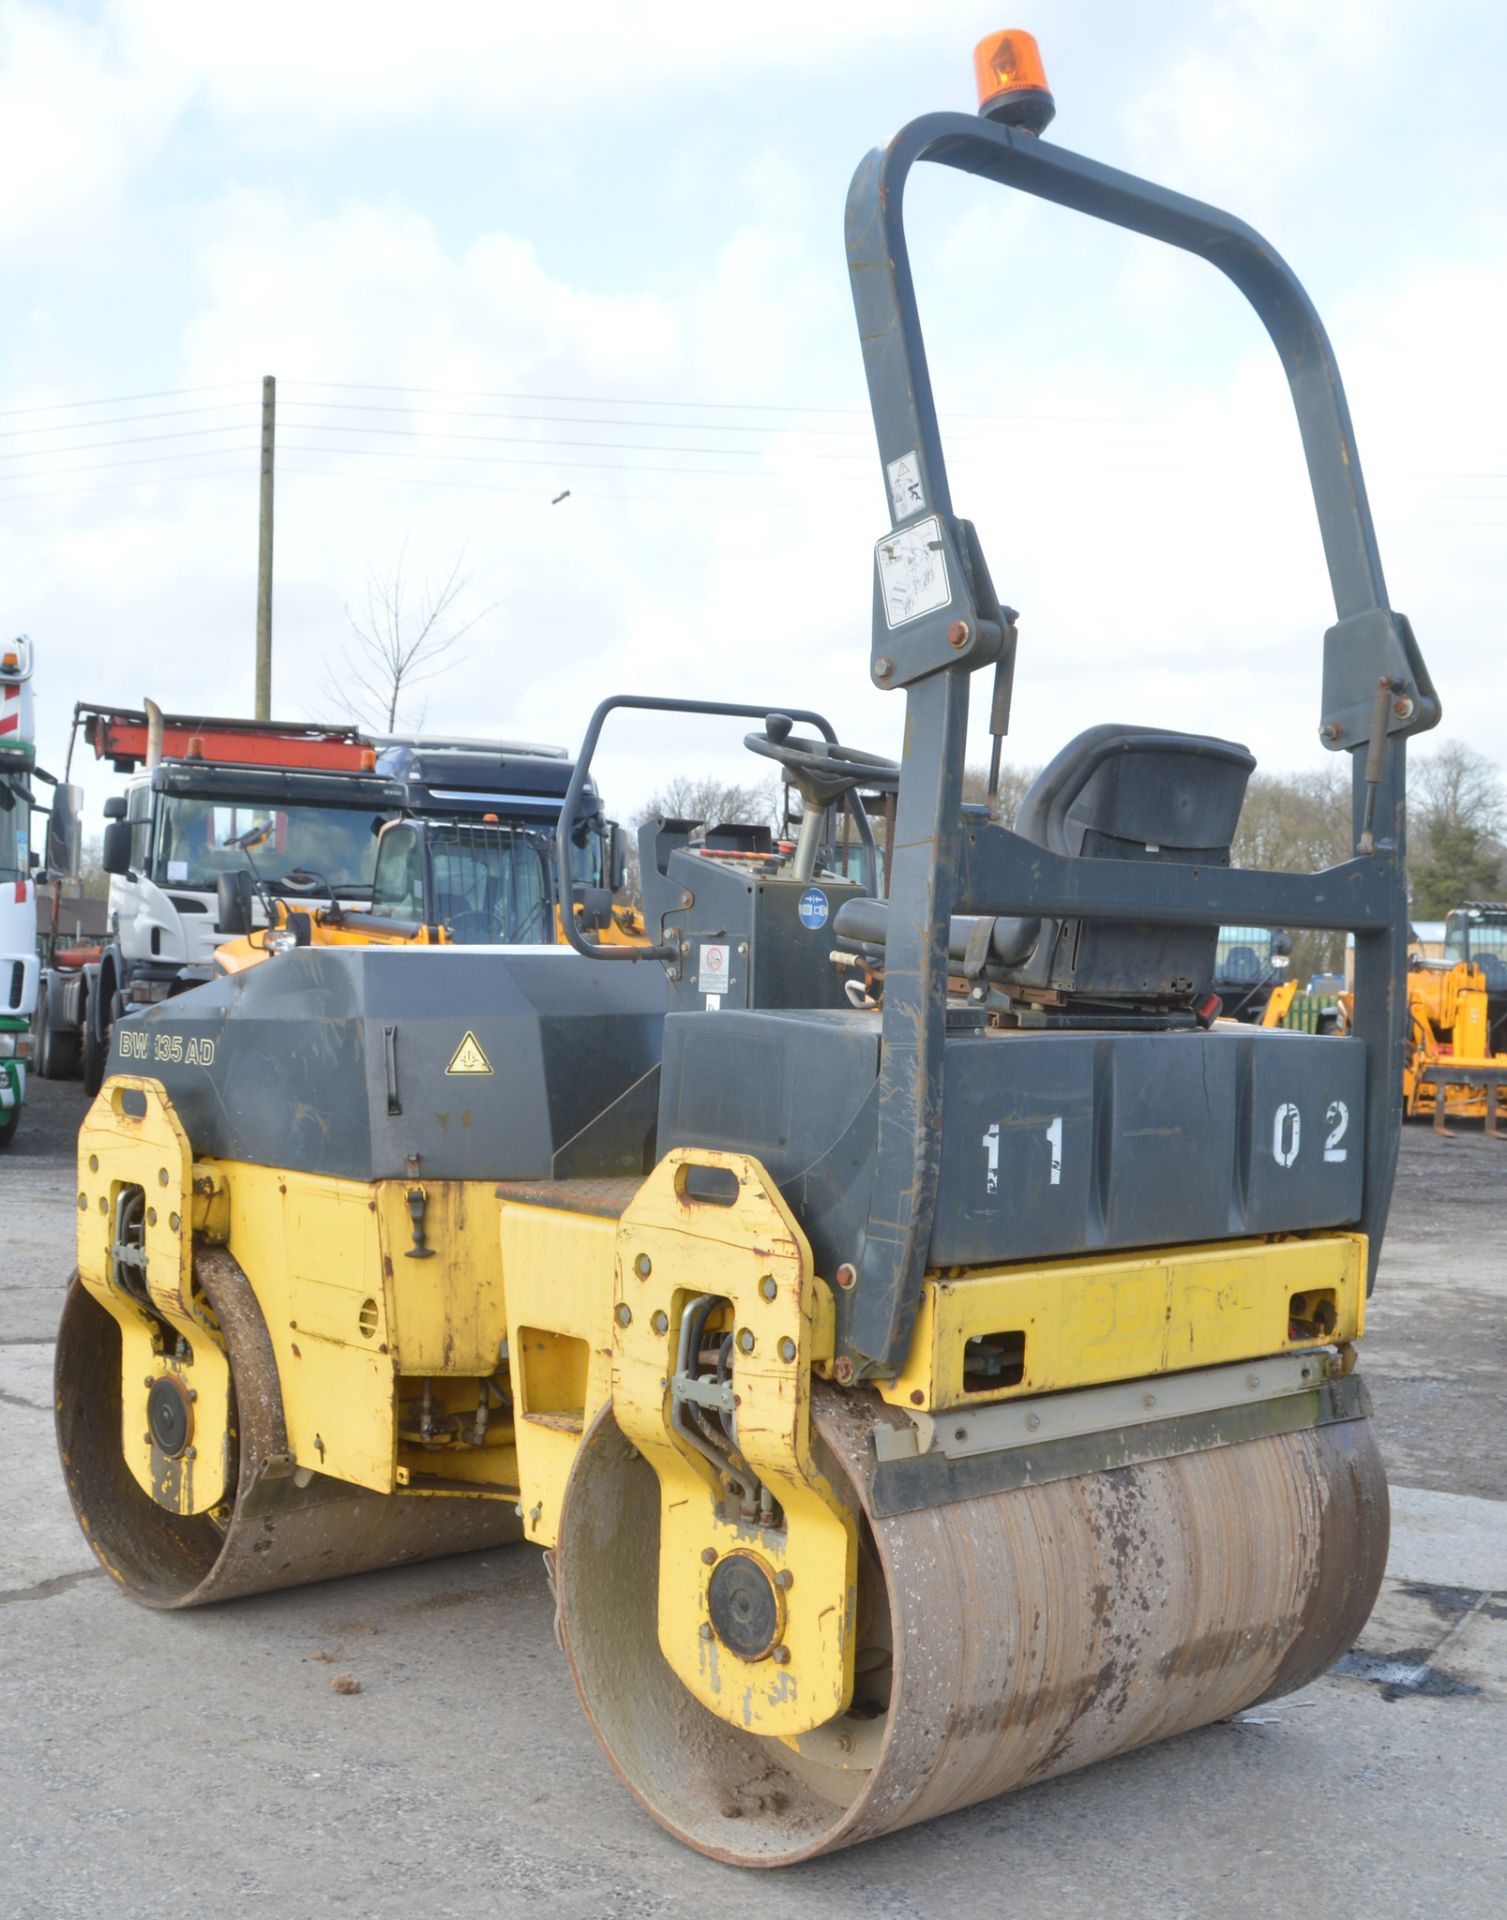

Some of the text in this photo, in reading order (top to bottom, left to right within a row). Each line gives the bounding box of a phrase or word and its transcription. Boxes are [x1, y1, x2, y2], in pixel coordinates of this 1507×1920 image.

[119, 1030, 215, 1066] BW 135 AD
